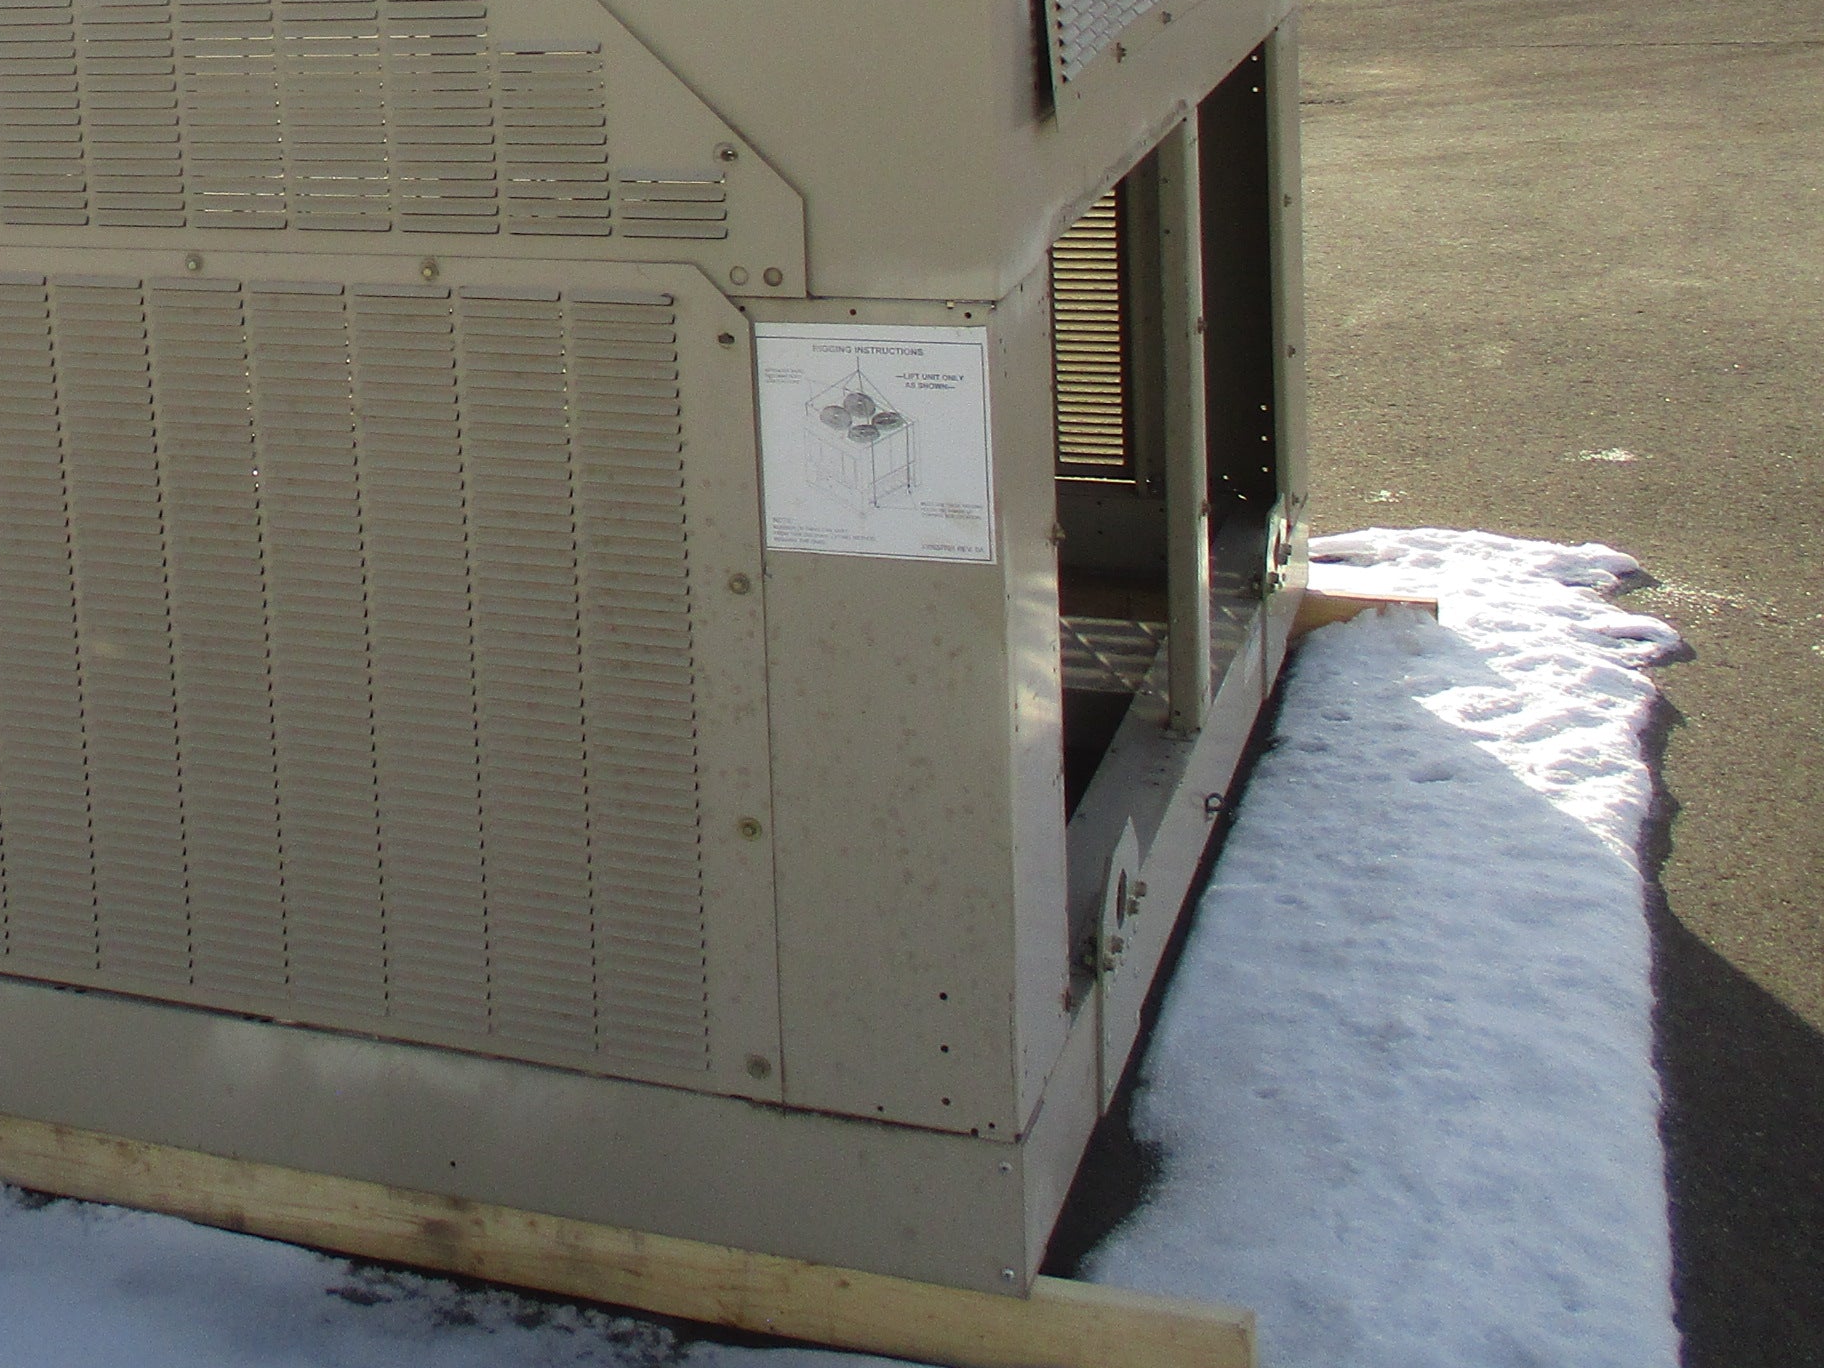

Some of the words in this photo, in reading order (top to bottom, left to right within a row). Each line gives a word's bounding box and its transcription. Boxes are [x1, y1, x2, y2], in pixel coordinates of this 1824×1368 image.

[812, 344, 852, 354] RIGGING
[854, 345, 924, 357] INSTRUCTIONS
[921, 373, 940, 381] UNIT
[941, 374, 964, 382] ONLY
